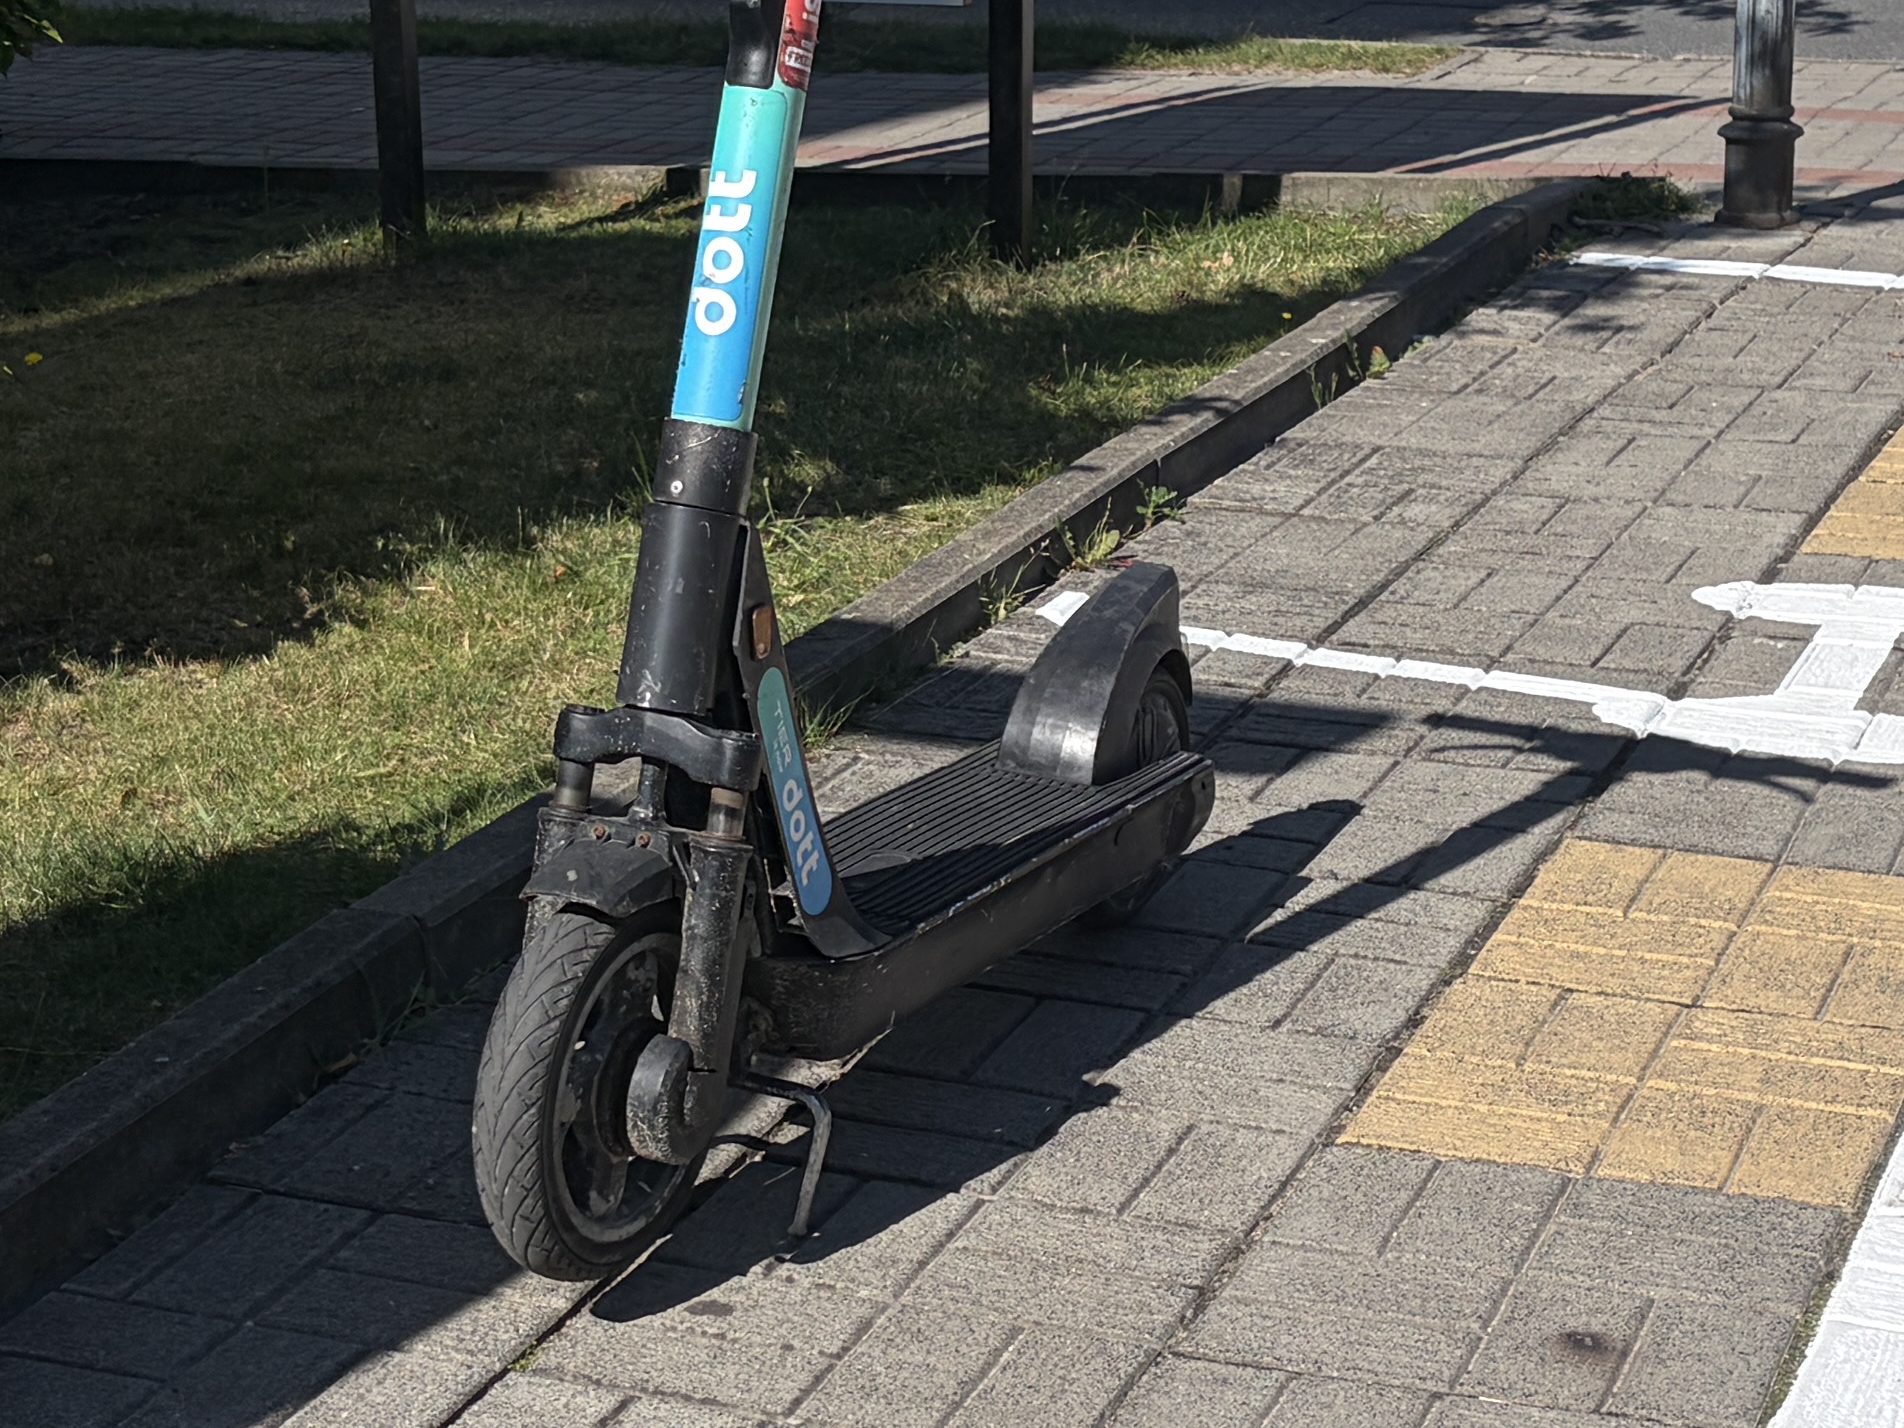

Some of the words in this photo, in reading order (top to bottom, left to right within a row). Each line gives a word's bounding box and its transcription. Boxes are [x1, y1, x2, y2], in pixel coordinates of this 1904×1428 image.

[692, 167, 758, 338] dott
[773, 699, 794, 768] TIER
[782, 778, 821, 887] dott
